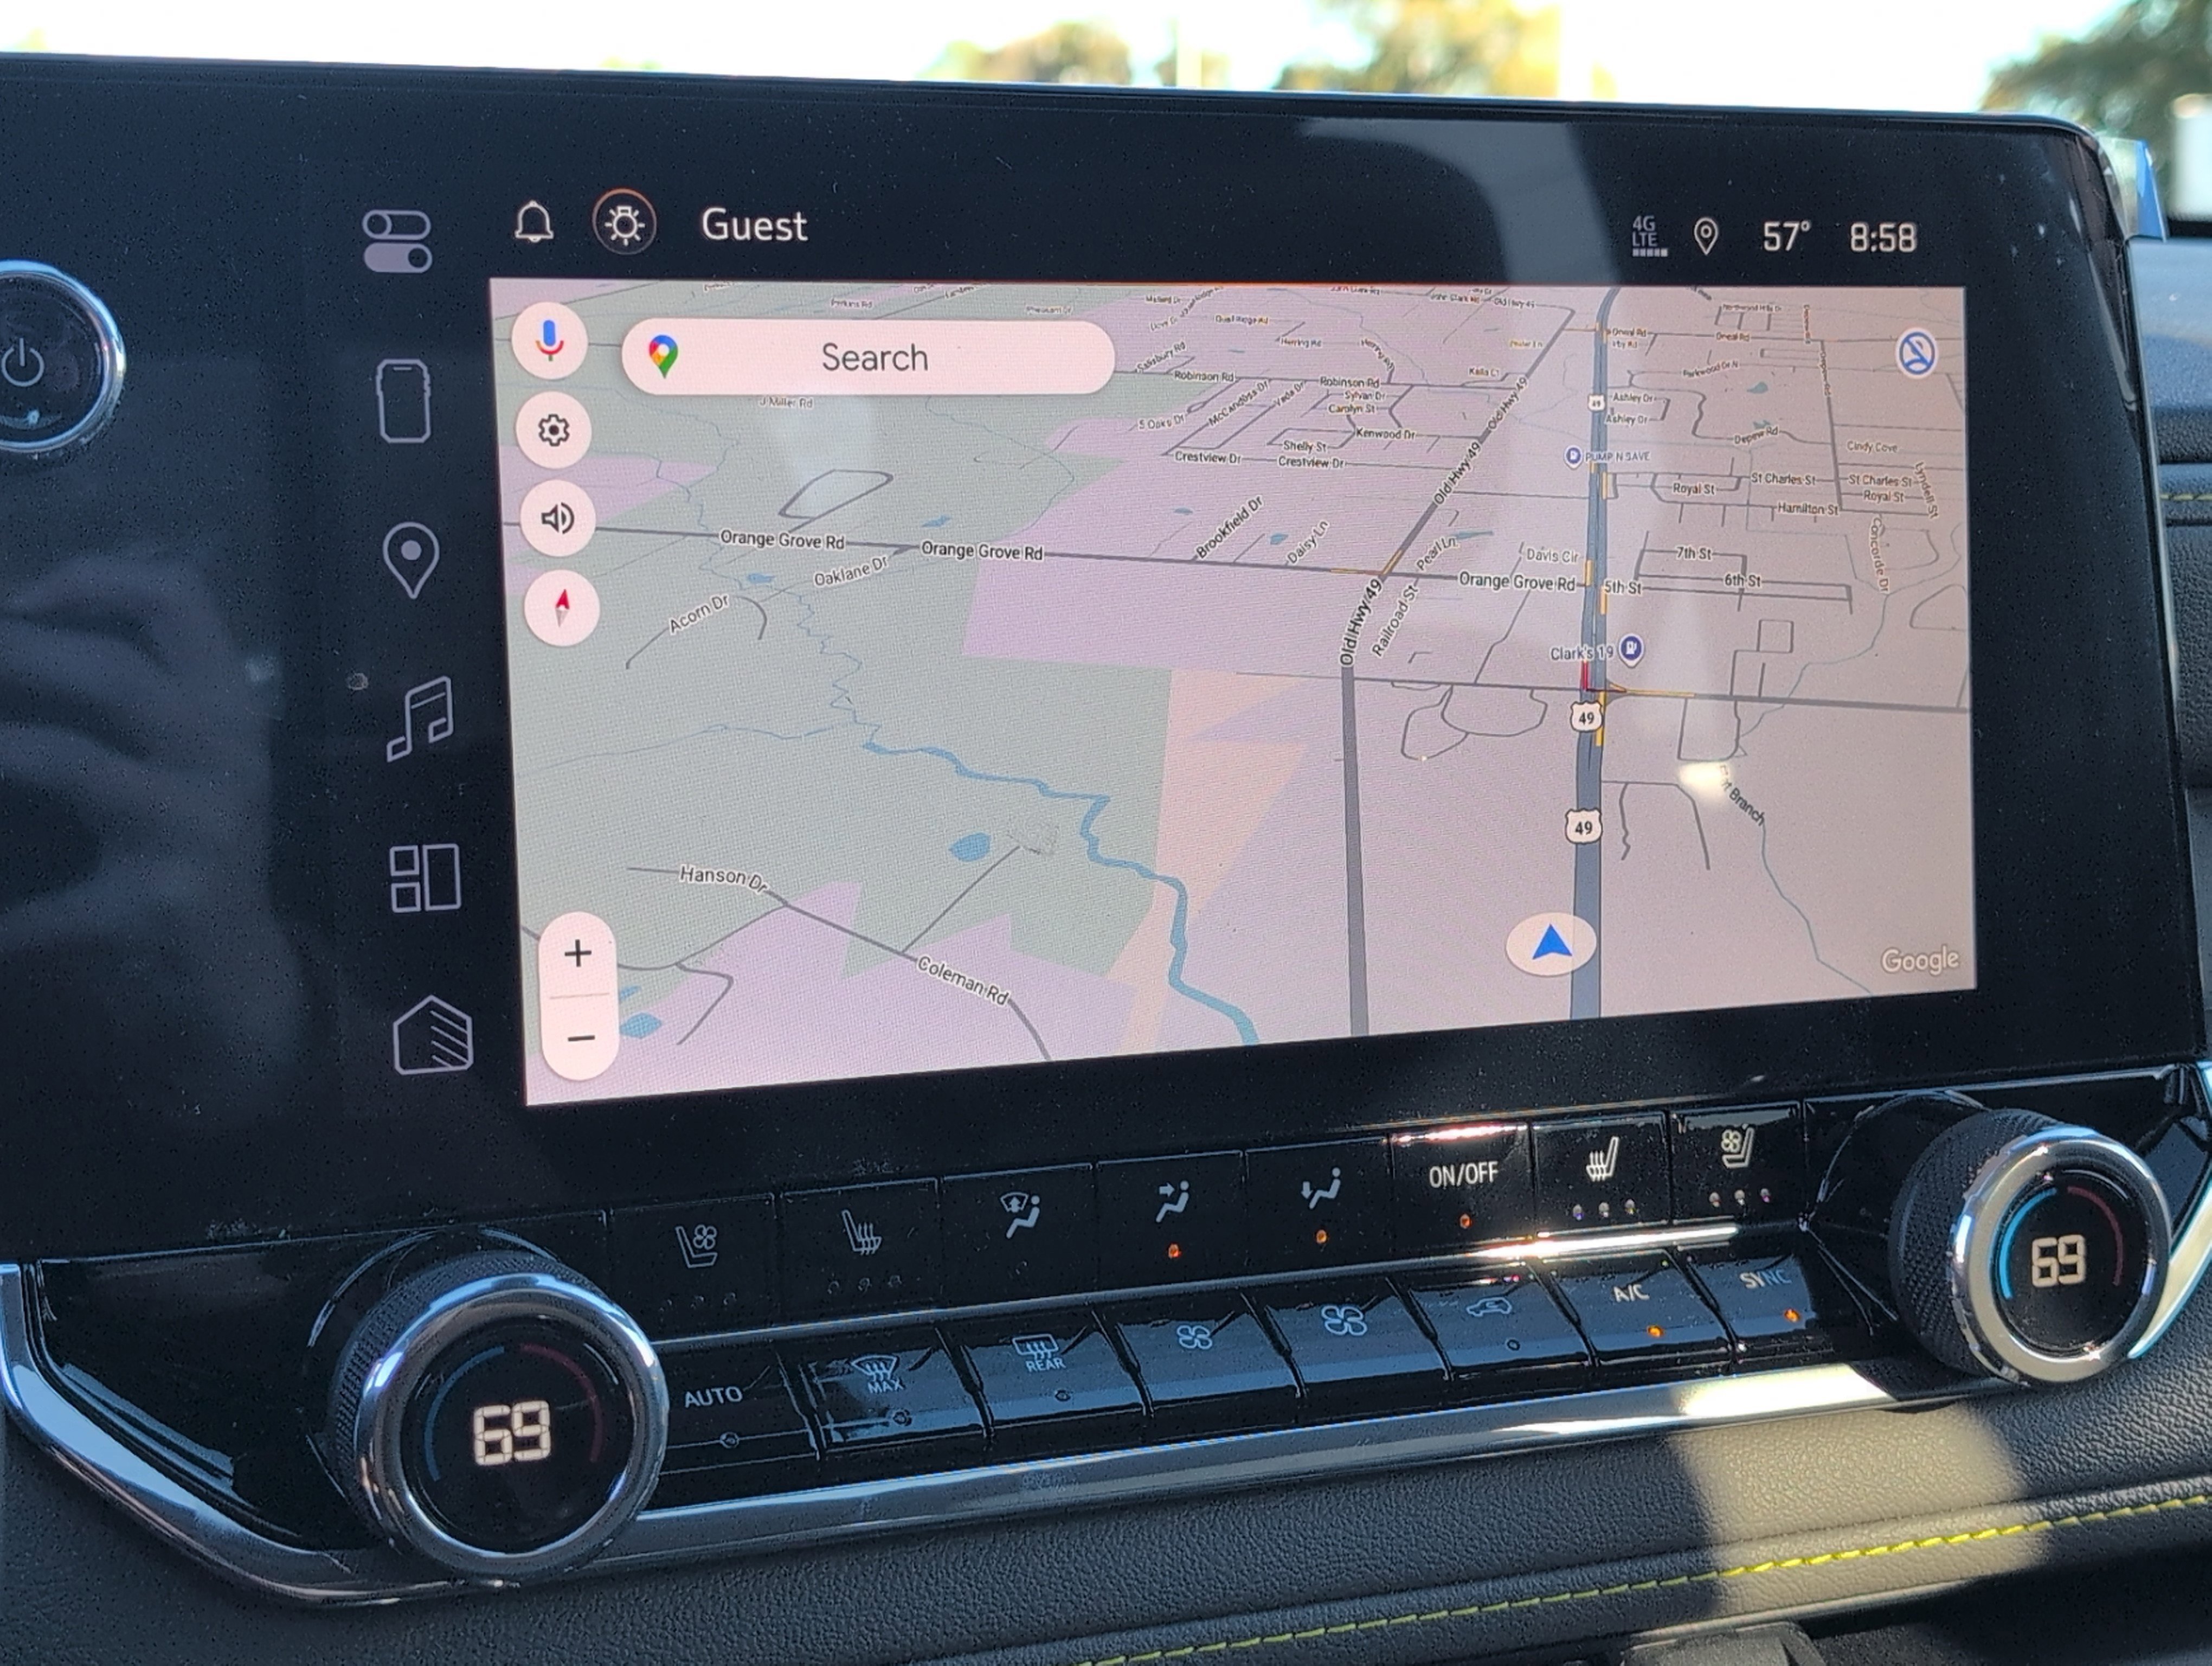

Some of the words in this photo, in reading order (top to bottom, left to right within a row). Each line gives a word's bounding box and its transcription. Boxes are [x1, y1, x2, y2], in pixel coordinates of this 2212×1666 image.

[702, 207, 809, 241] Guest
[1632, 215, 1656, 232] 4G
[1632, 233, 1657, 247] LTE
[1763, 220, 1812, 252] 57°
[1850, 222, 1918, 252] 8:58
[821, 342, 929, 371] Search
[1174, 371, 1219, 381] Robinson
[1221, 372, 1234, 381] Rd
[1320, 376, 1365, 387] Robinson
[1367, 378, 1380, 387] Rd
[799, 399, 813, 408] Rd
[1488, 410, 1503, 429] Old
[1501, 391, 1520, 414] Hwy
[1516, 377, 1528, 392] 49
[1612, 392, 1642, 403] Ashley
[1605, 414, 1636, 426] Ashley
[1356, 428, 1401, 438] Kenwood
[1765, 427, 1779, 436] Rd
[1283, 440, 1313, 453] Shelly
[1316, 443, 1327, 452] St
[1847, 441, 1873, 453] Cindy
[1875, 443, 1898, 453] Cove
[1175, 451, 1226, 463] Crestview
[1229, 453, 1242, 464] Dr
[1278, 456, 1329, 467] Crestview
[1332, 458, 1345, 467] Dr
[1434, 483, 1452, 505] Old
[1448, 459, 1471, 486] Hwy
[1468, 442, 1481, 461] 49
[1751, 473, 1763, 483] St
[1765, 475, 1803, 485] Charles
[1805, 476, 1816, 485] St
[1848, 475, 1860, 485] St
[1862, 476, 1900, 487] Charles
[1901, 478, 1913, 488] St
[1673, 483, 1702, 497] Royal
[1703, 484, 1715, 495] St
[1863, 490, 1892, 503] Royal
[1893, 492, 1905, 502] St
[1915, 460, 1935, 505] Lyndell
[1927, 503, 1939, 519] St
[1777, 502, 1825, 515] Hamilton
[1827, 505, 1839, 516] St
[1195, 506, 1250, 559] Brookfield
[1248, 496, 1263, 512] Dr
[721, 529, 775, 549] Orange
[779, 532, 821, 549] Grove
[826, 535, 845, 550] Rd
[1287, 536, 1317, 564] Daisy
[1313, 521, 1328, 536] Ln
[921, 540, 975, 560] Orange
[978, 543, 1020, 560] Grove
[1024, 546, 1043, 561] Rd
[1526, 548, 1559, 562] Davis
[1561, 550, 1579, 563] Cir
[1676, 546, 1696, 559] 7th
[1698, 548, 1712, 560] St
[1870, 517, 1883, 576] Concorde
[1879, 578, 1889, 592] Dr
[814, 564, 870, 586] Oaklane
[871, 556, 889, 569] Dr
[1365, 578, 1382, 599] 49
[1459, 571, 1510, 591] Orange
[1513, 574, 1554, 590] Grove
[1557, 577, 1576, 592] Rd
[1604, 580, 1625, 594] 5th
[1627, 582, 1643, 595] St
[1724, 575, 1744, 587] 6th
[1747, 576, 1761, 588] St
[669, 605, 711, 633] Acorn
[711, 594, 730, 611] Dr
[1347, 599, 1372, 635] Hwy
[1372, 599, 1409, 657] Railroad
[1403, 585, 1419, 601] St
[1340, 637, 1358, 666] Old
[1550, 646, 1593, 661] Clark's
[1597, 646, 1614, 658] 19
[1578, 712, 1594, 725] 49
[1728, 787, 1765, 827] Branch
[1574, 820, 1593, 835] 49
[679, 866, 748, 886] Hanson
[748, 874, 768, 893] Dr
[1881, 945, 1959, 976] Google
[918, 957, 985, 996] Coleman
[986, 985, 1010, 1007] Rd
[1429, 1161, 1499, 1189] ON/OFF
[2031, 1234, 2087, 1288] 69
[1739, 1269, 1792, 1290] SYNC
[1613, 1283, 1650, 1303] A/C
[1025, 1357, 1066, 1373] REAR
[868, 1378, 905, 1394] MAX
[684, 1386, 743, 1408] AUTO
[473, 1400, 551, 1466] 69
